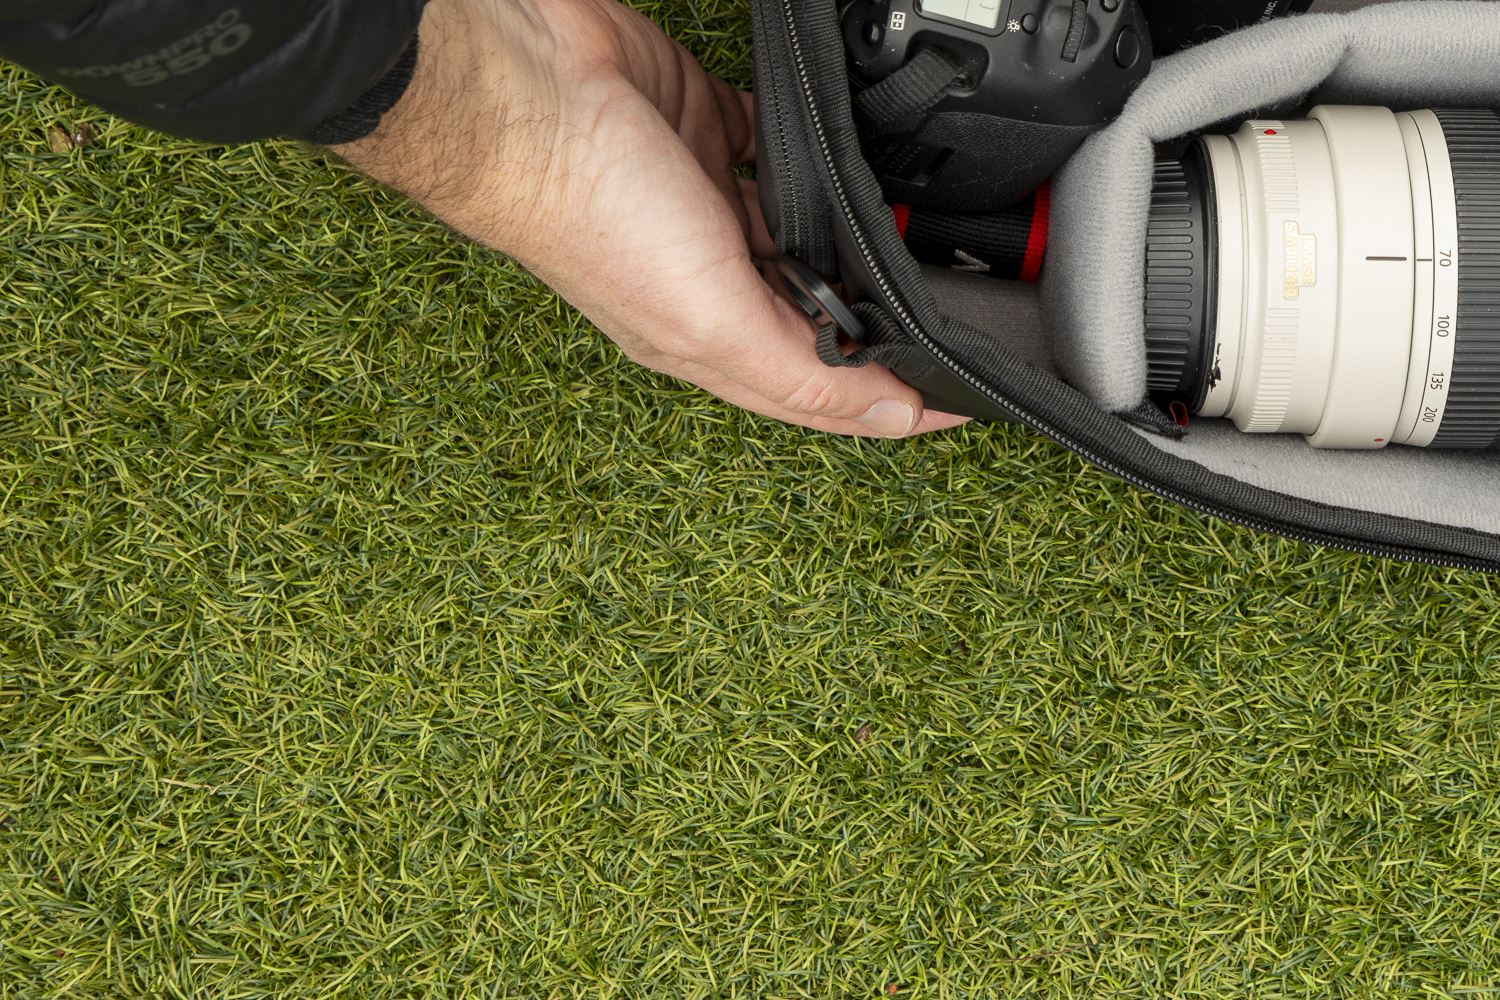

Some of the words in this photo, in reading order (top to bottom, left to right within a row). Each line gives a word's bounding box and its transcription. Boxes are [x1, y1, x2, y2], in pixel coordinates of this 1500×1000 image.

[121, 23, 252, 87] 550
[1284, 222, 1298, 298] STABILIZER
[1302, 235, 1315, 285] IMAGE
[1439, 250, 1451, 267] 70
[1437, 315, 1450, 338] 100
[1430, 372, 1444, 390] 135
[1423, 406, 1438, 422] 200
